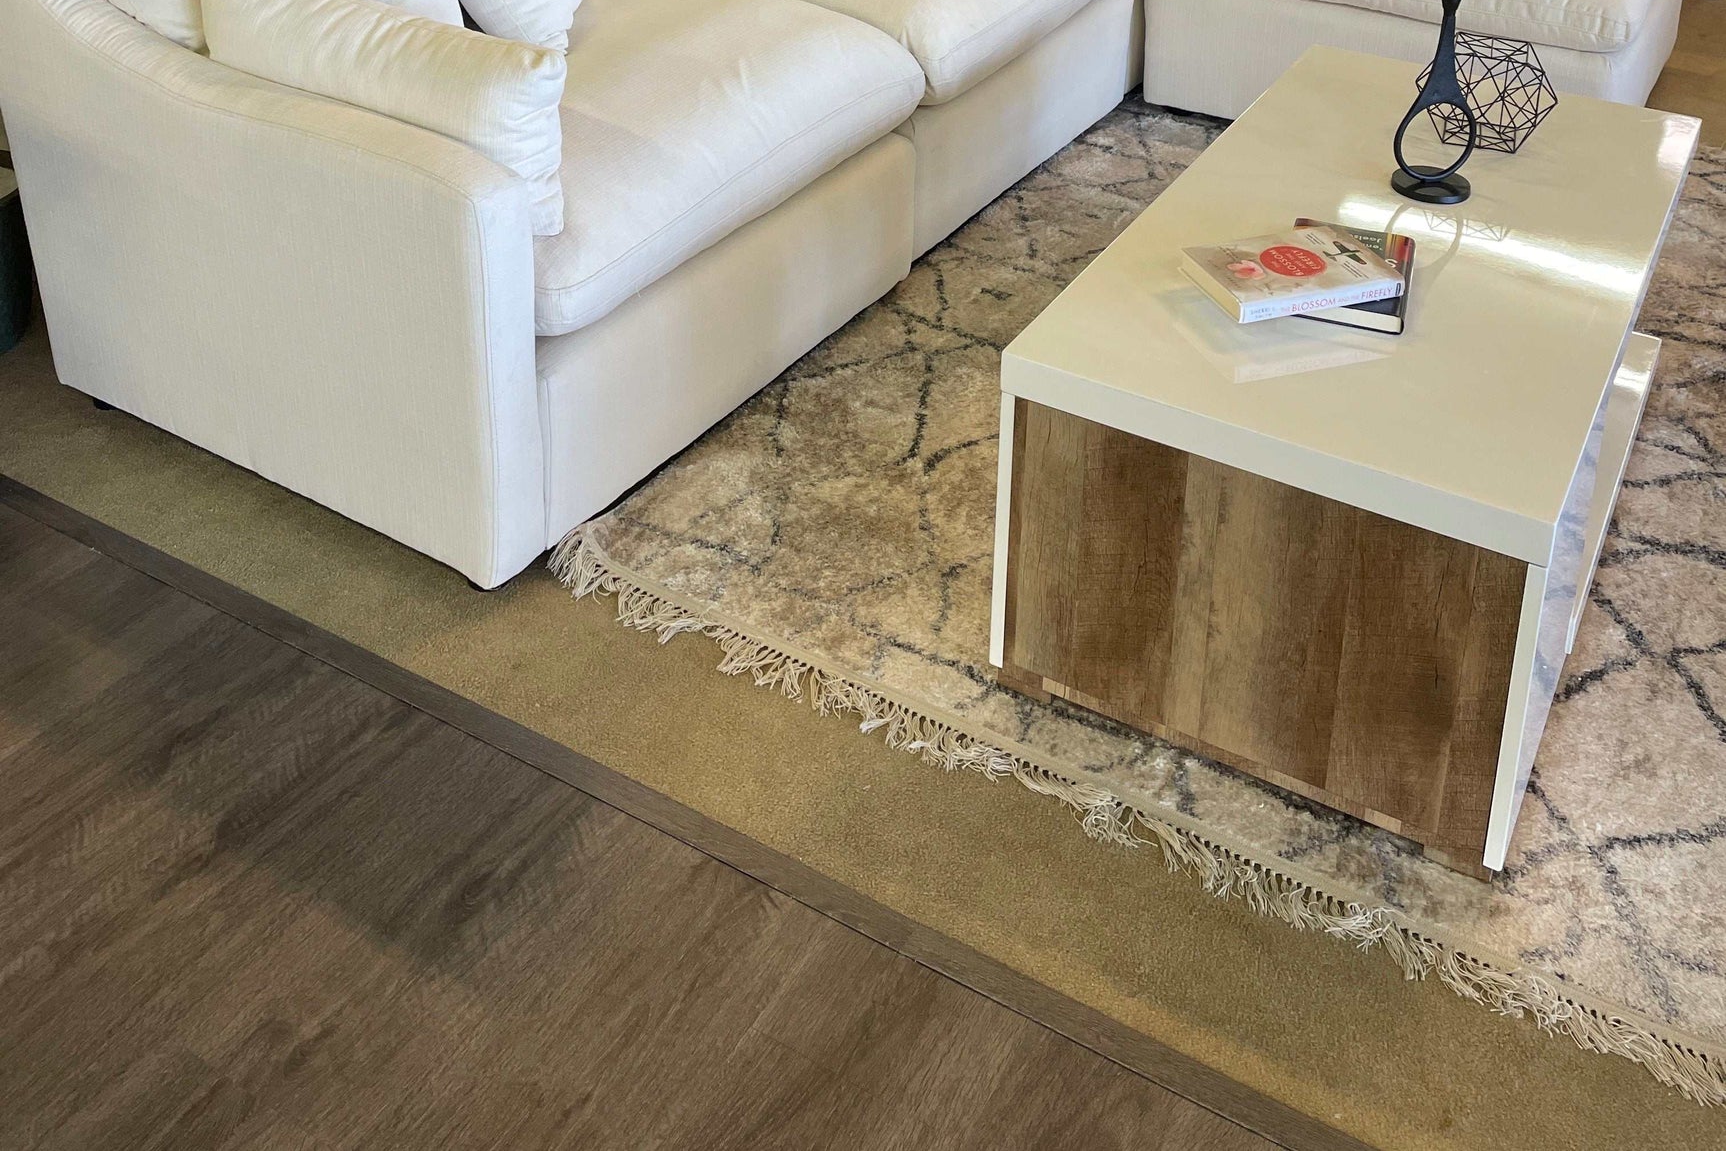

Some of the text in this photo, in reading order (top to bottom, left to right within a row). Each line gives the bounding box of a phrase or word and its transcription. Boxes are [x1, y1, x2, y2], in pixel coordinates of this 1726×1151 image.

[1268, 249, 1304, 276] BLOSSOM
[1291, 250, 1321, 270] FIREFLY
[1291, 298, 1336, 312] BLOSSOM
[1360, 287, 1393, 301] FIREFLY
